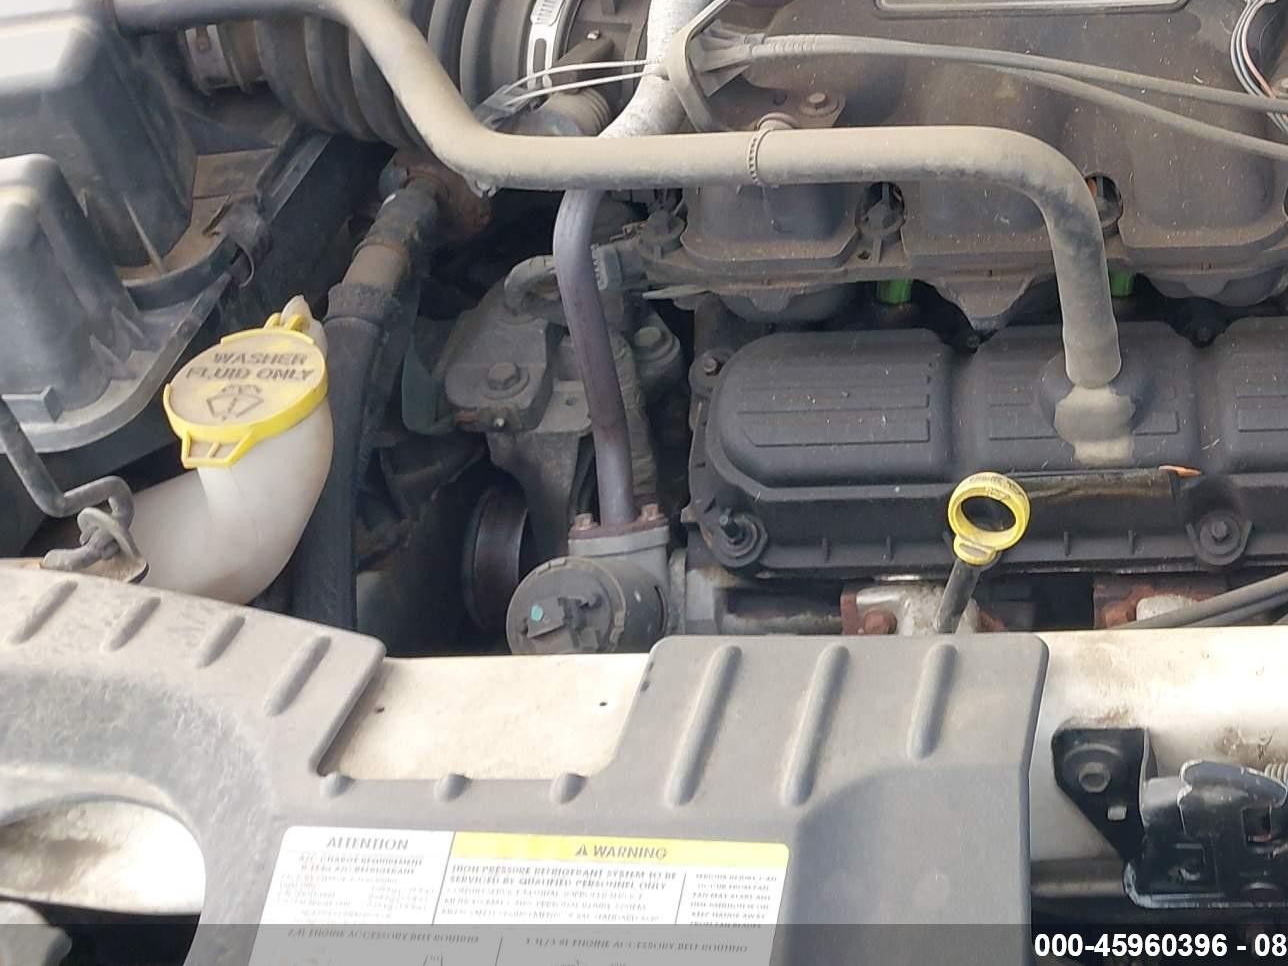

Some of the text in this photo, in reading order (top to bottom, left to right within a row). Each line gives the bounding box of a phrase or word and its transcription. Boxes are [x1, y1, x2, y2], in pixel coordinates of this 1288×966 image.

[212, 352, 307, 365] WASHER
[186, 367, 315, 381] FLUID ONLY
[326, 836, 409, 851] ATTENTION
[592, 844, 668, 859] WARNING
[481, 865, 531, 875] PRESSURE
